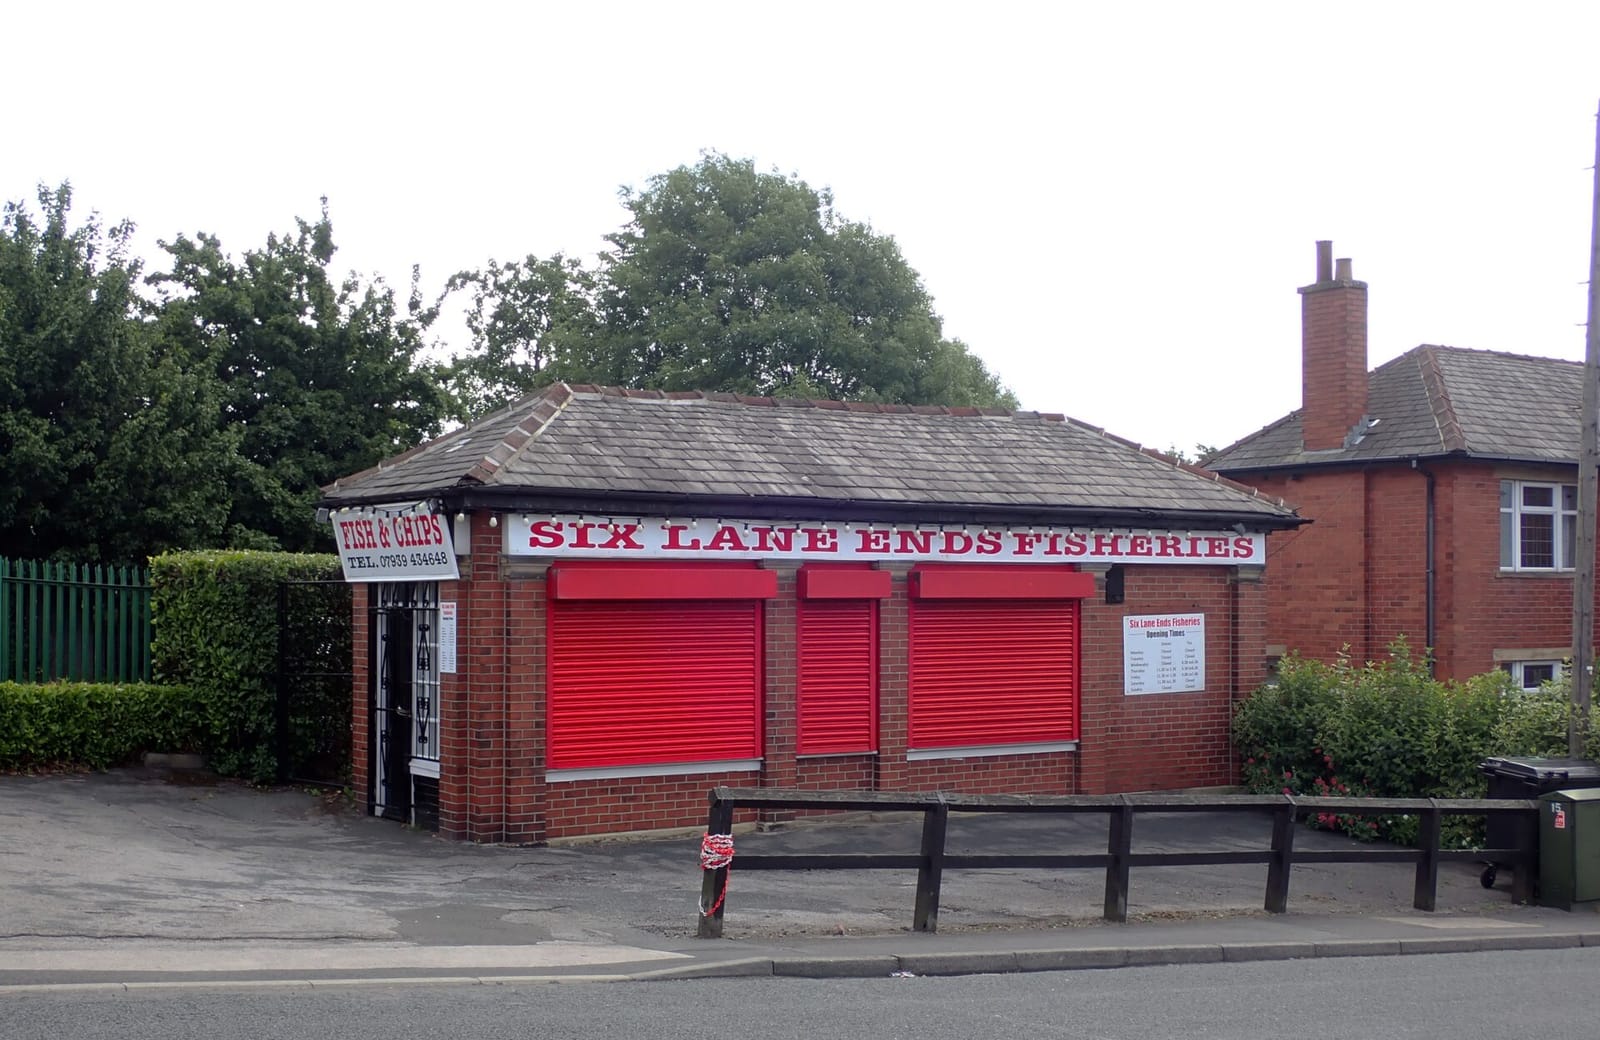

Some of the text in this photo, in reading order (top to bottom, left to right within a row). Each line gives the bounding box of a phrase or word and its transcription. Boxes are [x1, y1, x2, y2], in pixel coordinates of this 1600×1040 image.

[340, 514, 443, 549] FISH & CHIPS
[529, 521, 1253, 559] SIX LANE ENDS FISHERIES
[348, 552, 448, 568] TEL. 07939 434648
[1130, 617, 1200, 628] Six Lane Ends Fisheries
[1146, 629, 1185, 638] Opening Times
